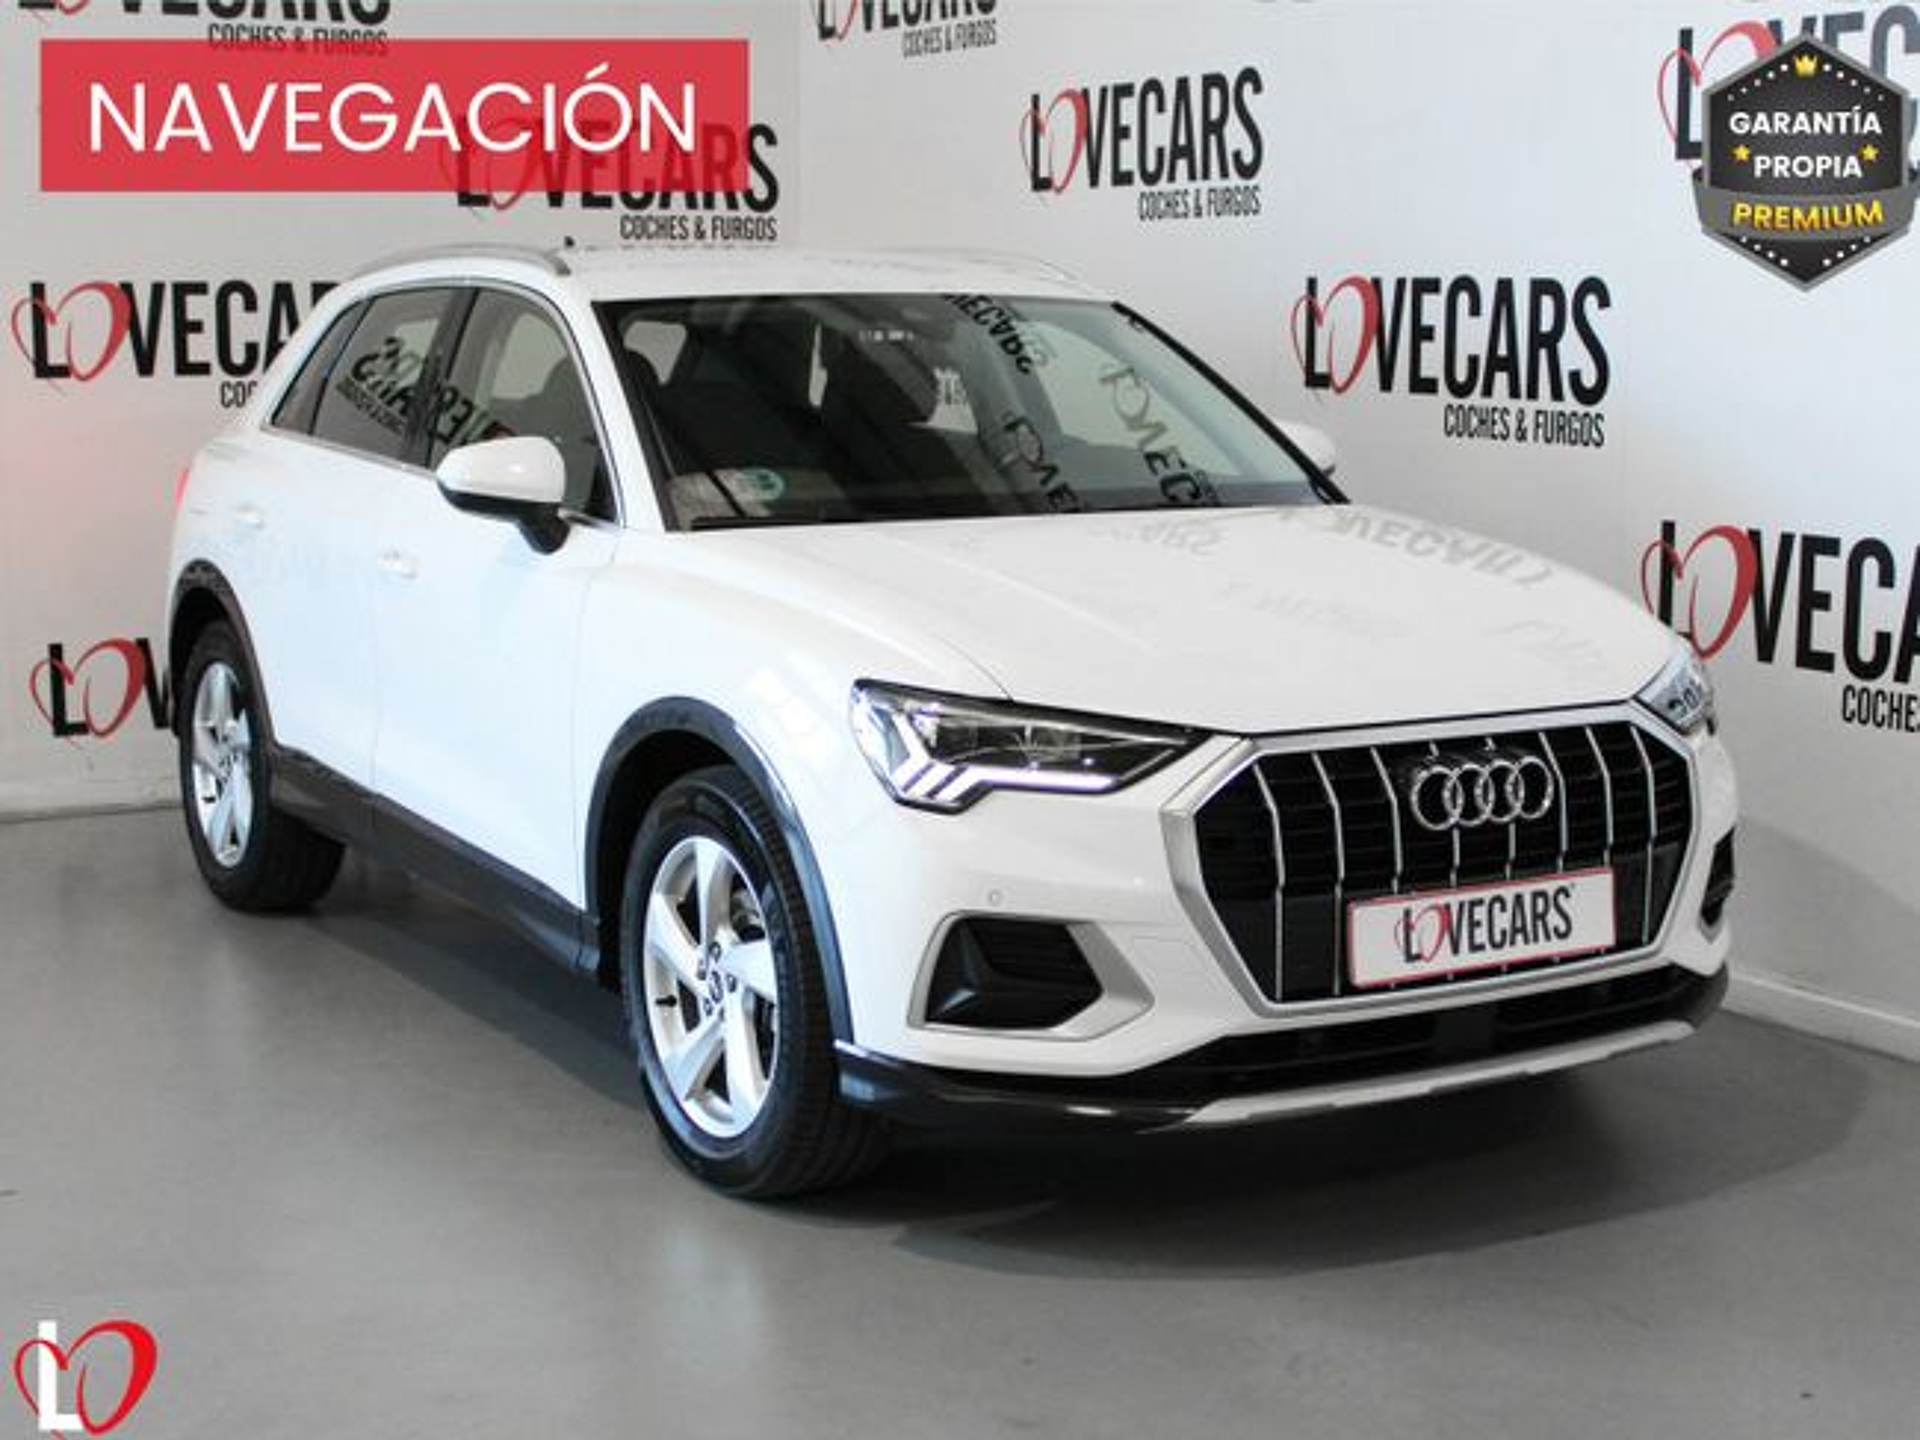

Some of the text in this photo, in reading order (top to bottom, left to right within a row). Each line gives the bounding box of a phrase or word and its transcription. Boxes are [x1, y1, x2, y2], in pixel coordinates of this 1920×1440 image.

[1020, 66, 1263, 195] LOVECARS
[619, 214, 689, 240] COCHES
[711, 216, 778, 241] FURGOS
[1138, 189, 1189, 221] COCHES
[1207, 185, 1262, 217] FURGOS
[11, 280, 340, 383] LOVECA
[1290, 275, 1612, 406] LOVECARS
[1443, 404, 1606, 448] COCHES & FURGOS
[1842, 684, 1920, 733] COCHE
[1394, 886, 1573, 964] LOVECARS
